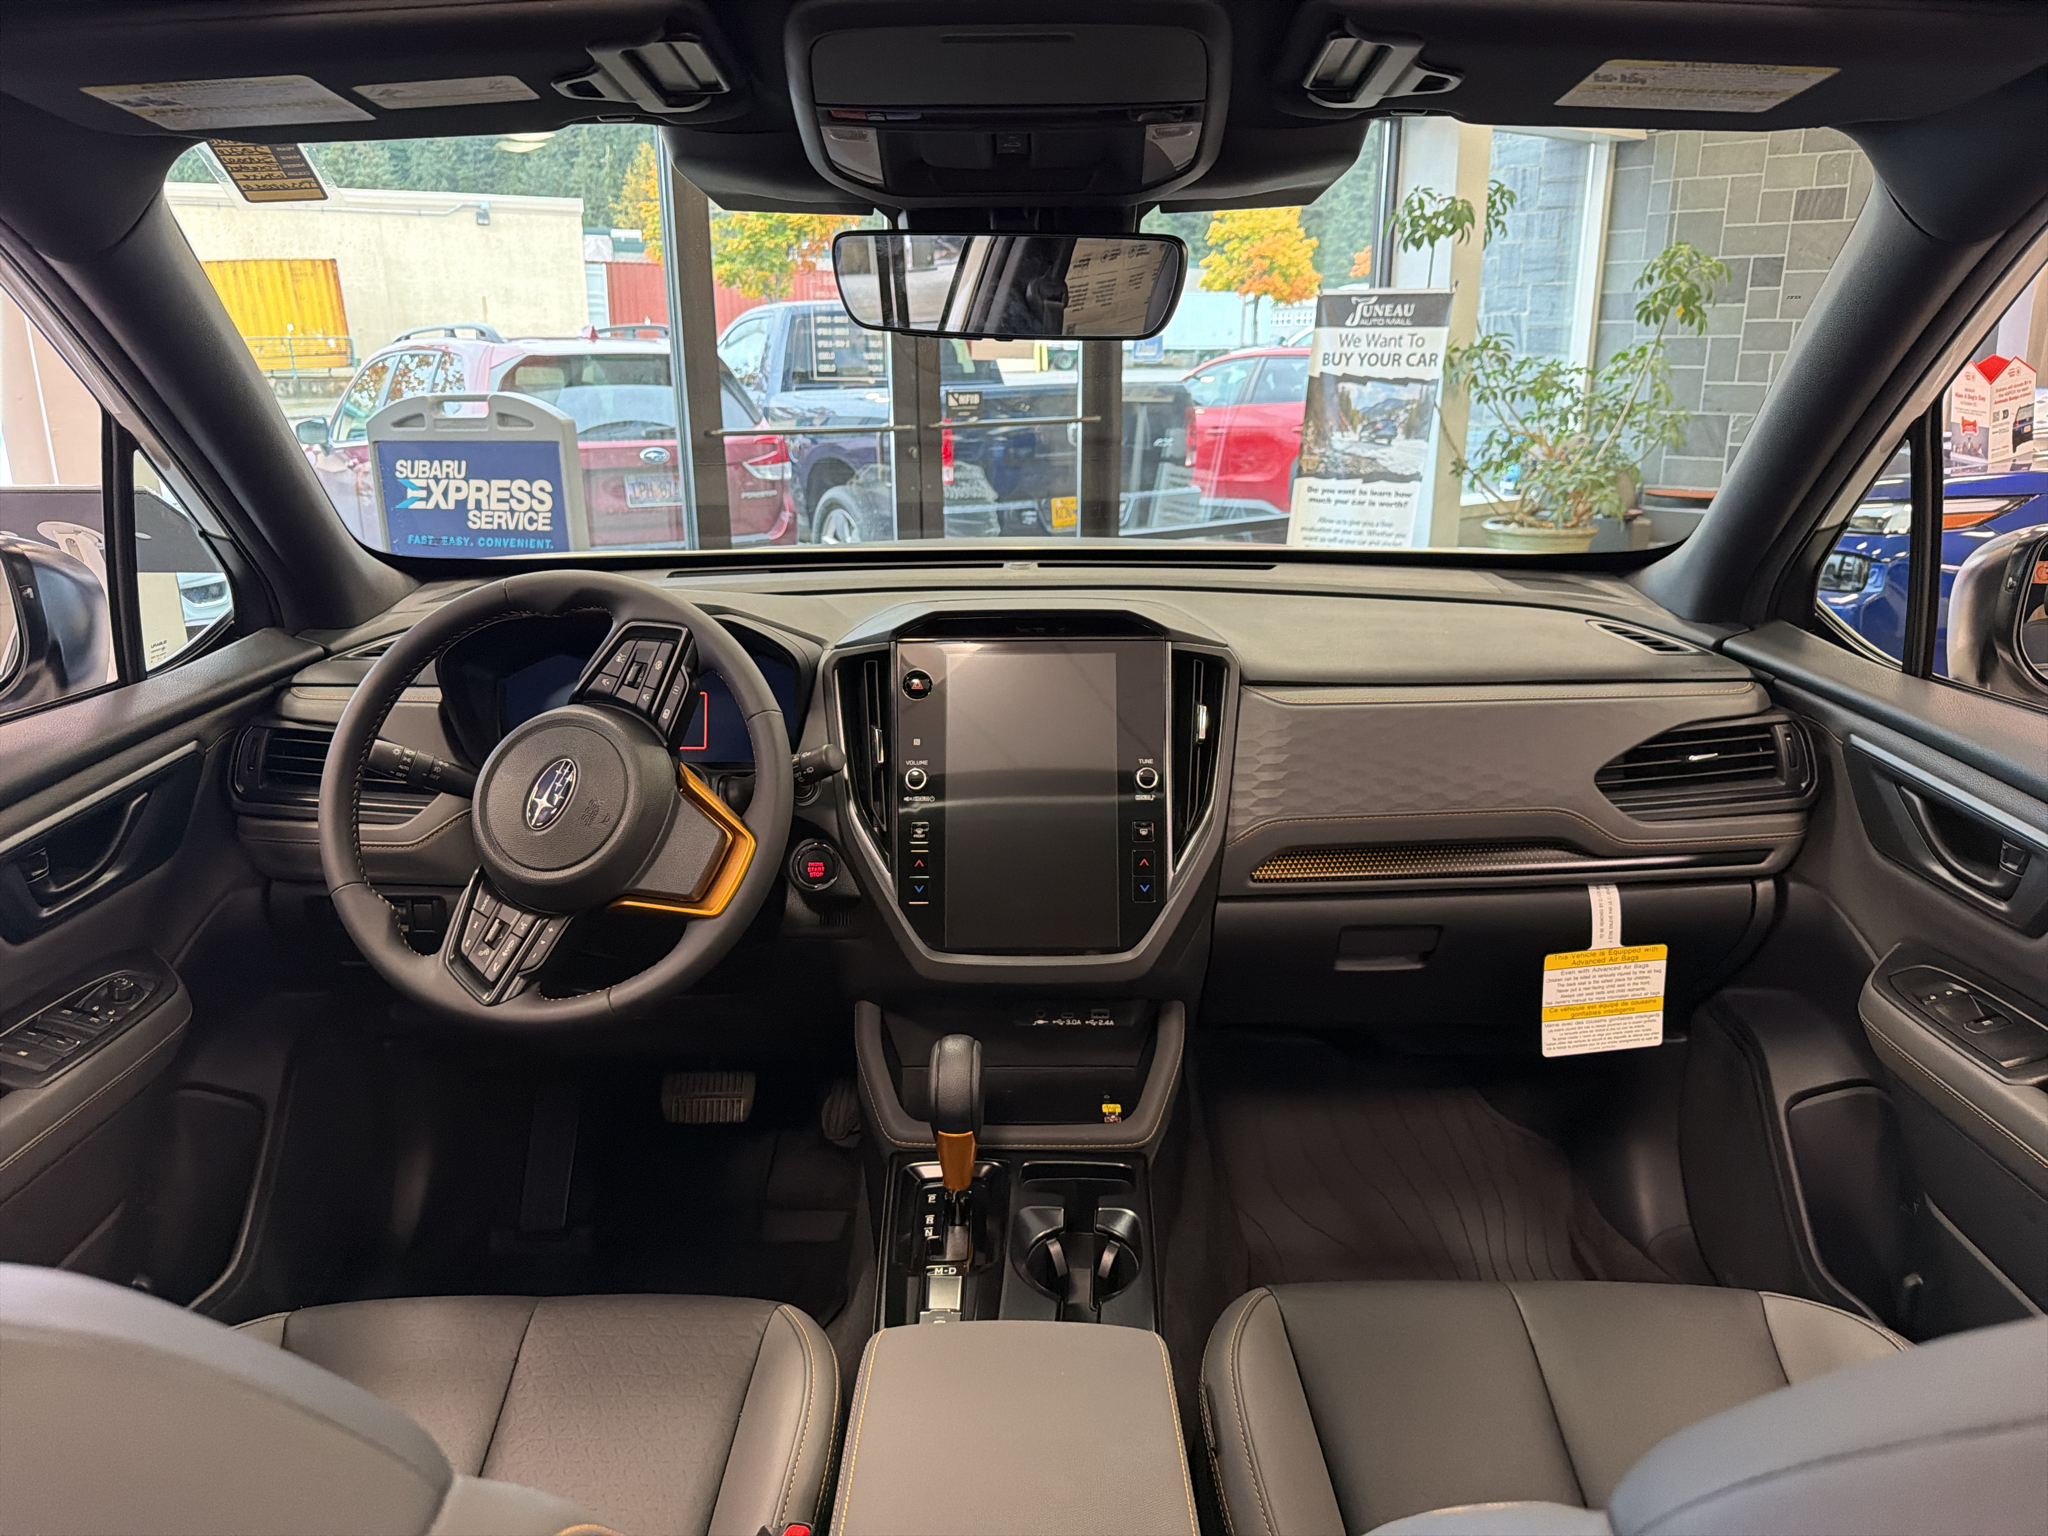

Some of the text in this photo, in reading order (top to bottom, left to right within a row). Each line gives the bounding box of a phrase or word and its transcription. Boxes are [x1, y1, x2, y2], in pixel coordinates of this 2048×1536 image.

[1345, 296, 1415, 326] JUNEAU
[1339, 333, 1425, 348] We Want To
[1322, 352, 1439, 367] BUY YOUR CAR
[395, 459, 467, 478] SUBARU
[396, 479, 553, 511] EXPRESS
[467, 510, 553, 531] SERVICE
[441, 536, 474, 547] EASY.
[478, 537, 554, 549] CONVENIENT.
[1608, 947, 1641, 958] Equipped
[1571, 954, 1639, 966] Advanced Air Bags
[1592, 965, 1621, 973] Advanced
[1630, 998, 1657, 1006] coussins
[1570, 1006, 1636, 1019] gonflables intelligents
[928, 1195, 936, 1203] P
[926, 1216, 934, 1224] R
[925, 1228, 933, 1237] N
